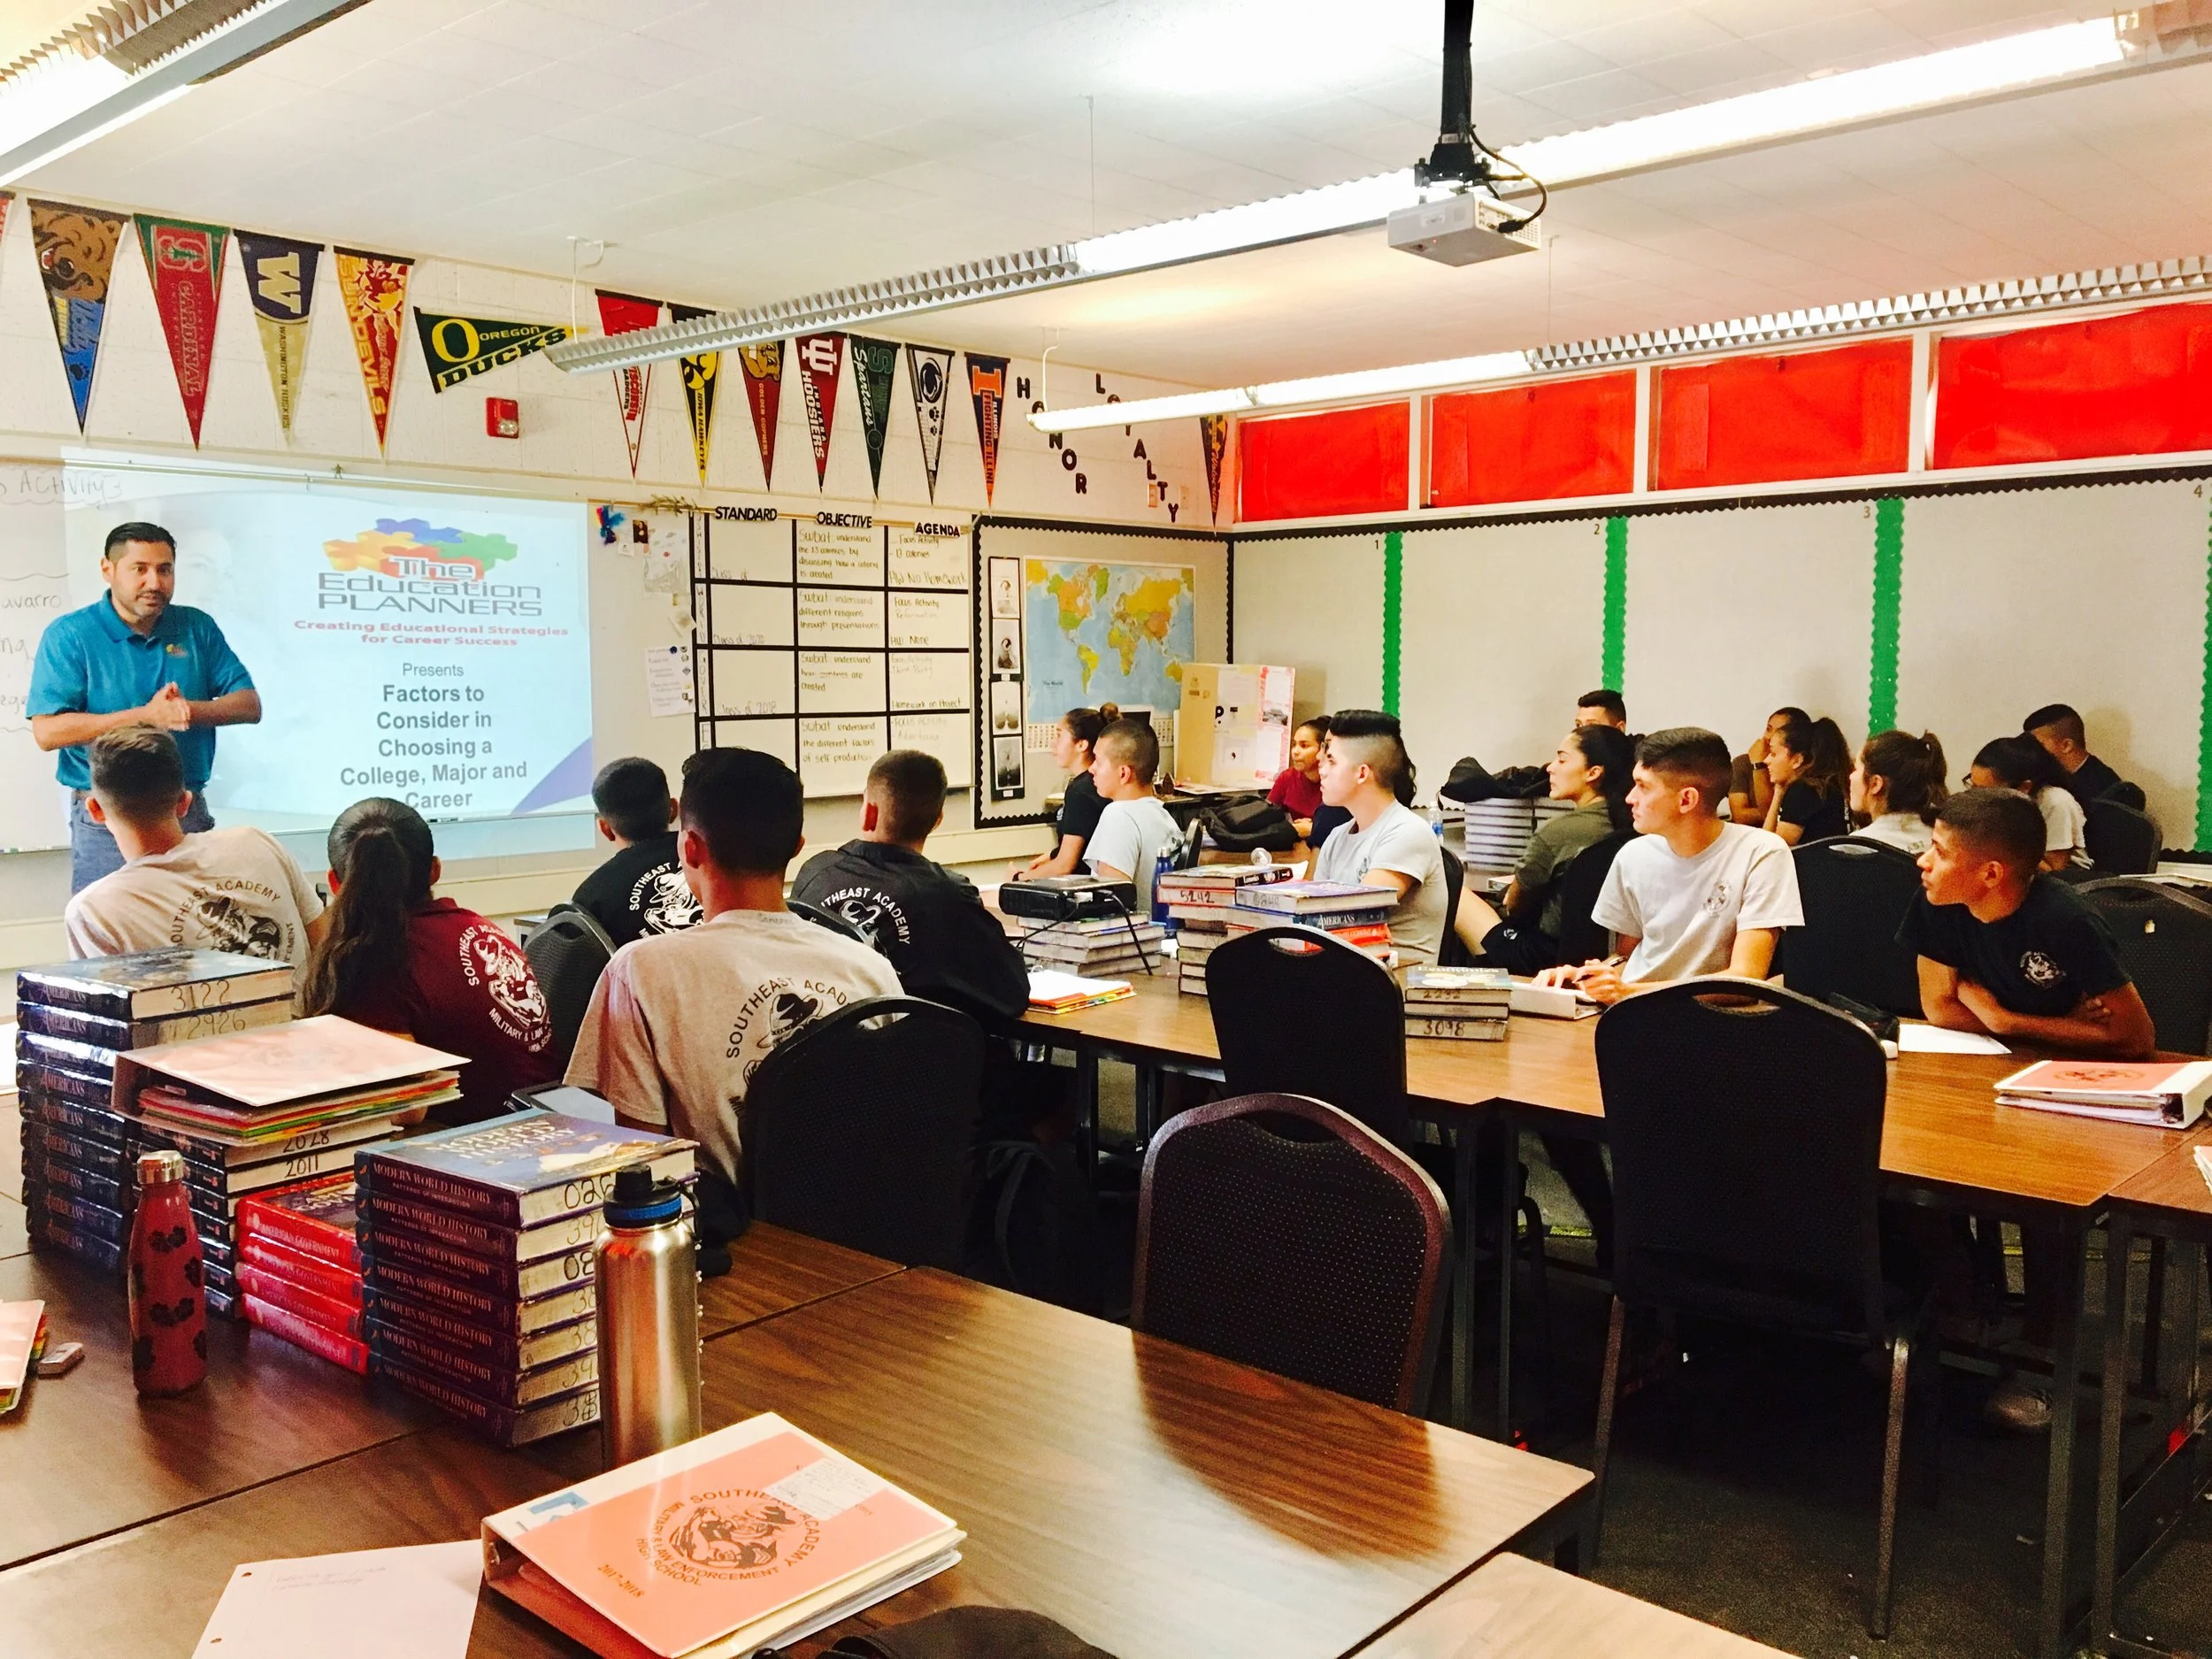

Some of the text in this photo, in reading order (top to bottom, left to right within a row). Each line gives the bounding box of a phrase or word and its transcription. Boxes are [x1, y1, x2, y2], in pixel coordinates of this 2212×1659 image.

[257, 251, 302, 314] W
[179, 280, 203, 396] CARDINAL
[432, 319, 480, 363] O
[480, 325, 541, 342] OREGON
[354, 320, 387, 416] DEVILS
[442, 326, 567, 388] DUCKS
[626, 365, 640, 422] ISCONSIN
[854, 346, 874, 426] Spartans
[801, 370, 825, 458] HOOSIERS
[983, 392, 995, 485] FIGHTING ILLINI
[2193, 484, 2203, 498] 4
[715, 506, 778, 521] STANDARD
[817, 511, 872, 528] OBJECTIVE
[1863, 505, 1871, 518] 3
[915, 522, 961, 538] AGENDA
[1594, 524, 1601, 535] 2
[1374, 540, 1379, 549] 1
[393, 557, 475, 578] The
[319, 572, 541, 599] Education
[319, 593, 542, 617] PLANNERS
[294, 619, 568, 637] Creating Educational Strategies
[361, 634, 518, 646] for Career Success
[403, 663, 465, 677] Presents
[383, 684, 485, 703] Factors to
[376, 710, 492, 729] Consider in
[378, 738, 493, 758] Choosing a
[340, 761, 527, 787] College, Major and
[405, 792, 473, 809] Career
[215, 879, 281, 902] ACADEMY
[629, 862, 672, 911] SOUTHEAST
[821, 887, 911, 946] THEAST ACADEMY
[459, 926, 480, 987] SOUTHEAST
[171, 979, 232, 1011] 3122
[488, 1007, 523, 1041] MILITARY
[726, 977, 848, 1058] SOUTHEAST ACAD
[424, 1120, 551, 1151] MODERN
[458, 1128, 574, 1159] HISTORY
[373, 1162, 491, 1205] MODERN WORLD HISTORY
[372, 1197, 410, 1217] MODERN
[411, 1208, 447, 1227] WORLD
[448, 1218, 488, 1240] HISTORY
[651, 1501, 780, 1581] MILITARY LAW ENFORCEMENT
[688, 1488, 821, 1567] SOUTHE ACADEMY
[652, 1559, 703, 1586] SCHOOL
